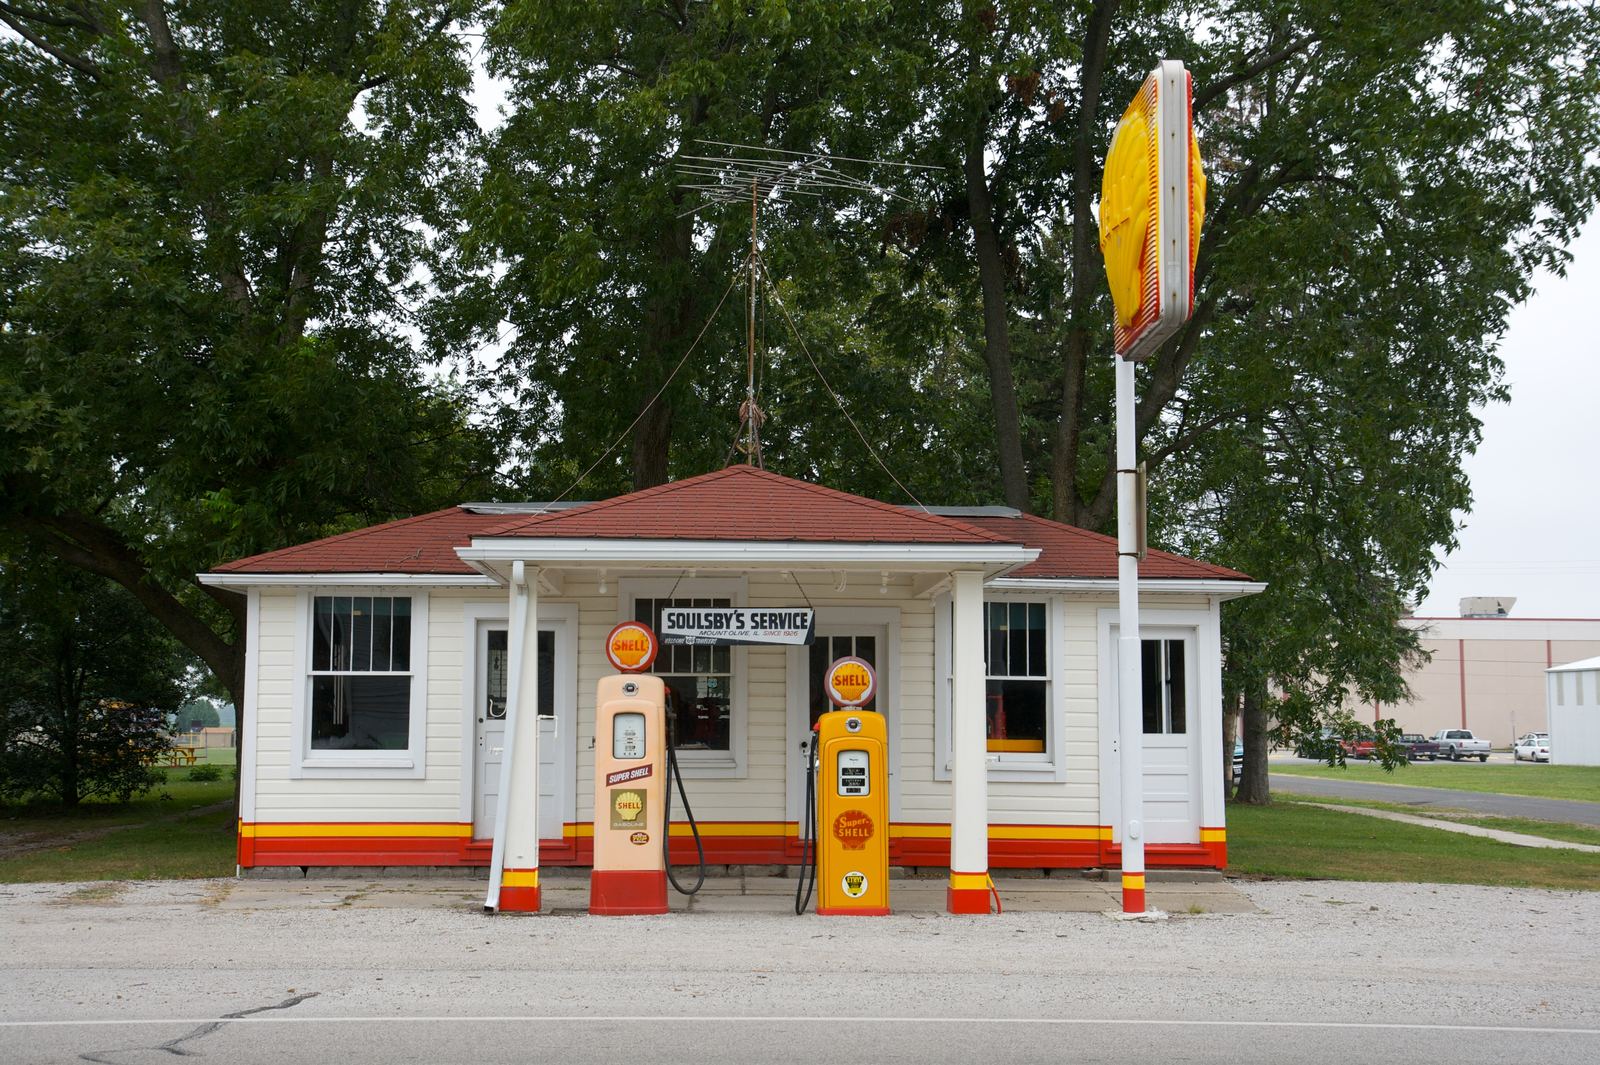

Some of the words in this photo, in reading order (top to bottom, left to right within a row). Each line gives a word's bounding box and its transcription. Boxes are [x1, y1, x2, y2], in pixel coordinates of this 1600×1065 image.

[667, 610, 745, 630] SOULSBY'S
[750, 612, 808, 630] SERVICE
[614, 639, 646, 652] SHELL
[834, 674, 867, 686] SHELL
[609, 770, 630, 784] SUPER
[630, 767, 649, 779] SHELL
[617, 802, 640, 810] SHELL
[838, 828, 870, 837] SHELL
